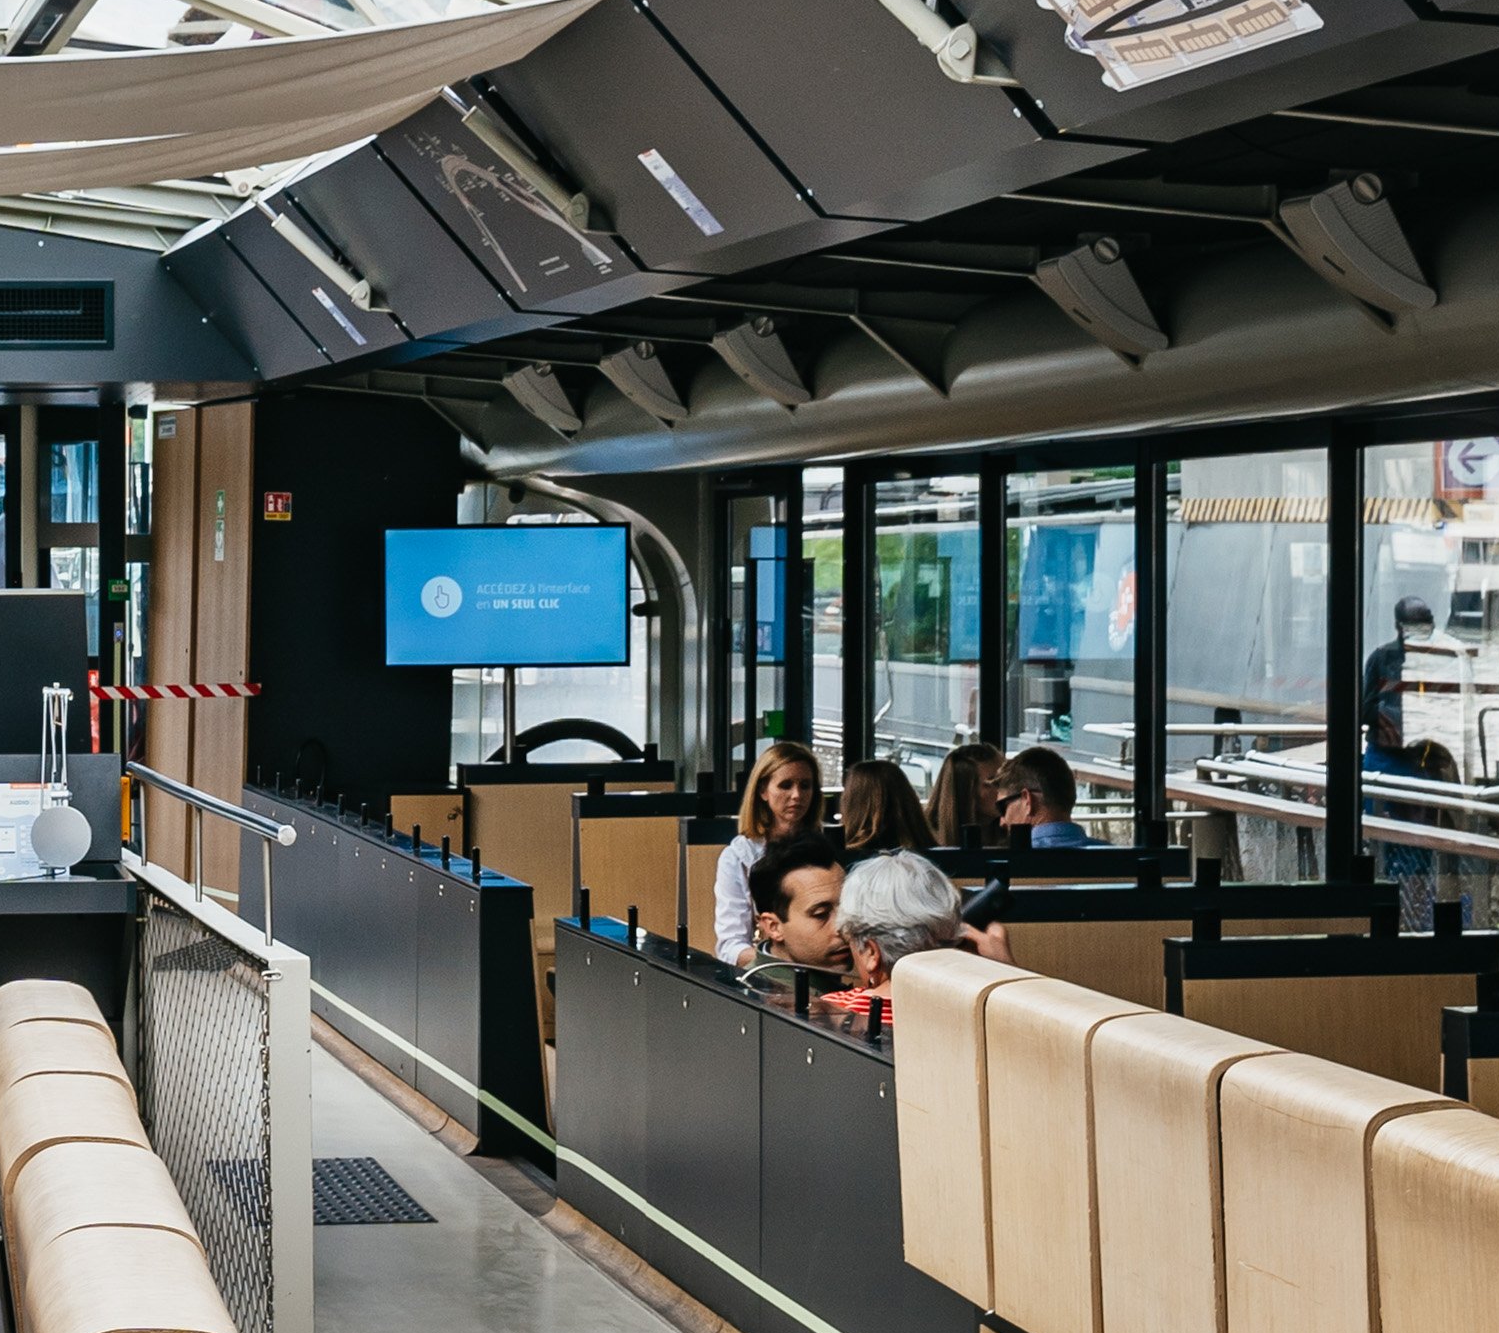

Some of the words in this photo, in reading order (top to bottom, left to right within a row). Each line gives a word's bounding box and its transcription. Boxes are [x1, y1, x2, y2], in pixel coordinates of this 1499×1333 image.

[476, 582, 527, 595] ACCÉDEZ
[528, 584, 536, 595] à
[476, 600, 491, 610] en
[492, 598, 509, 610] UN
[511, 598, 536, 610] SEUL
[538, 598, 560, 609] CLIC
